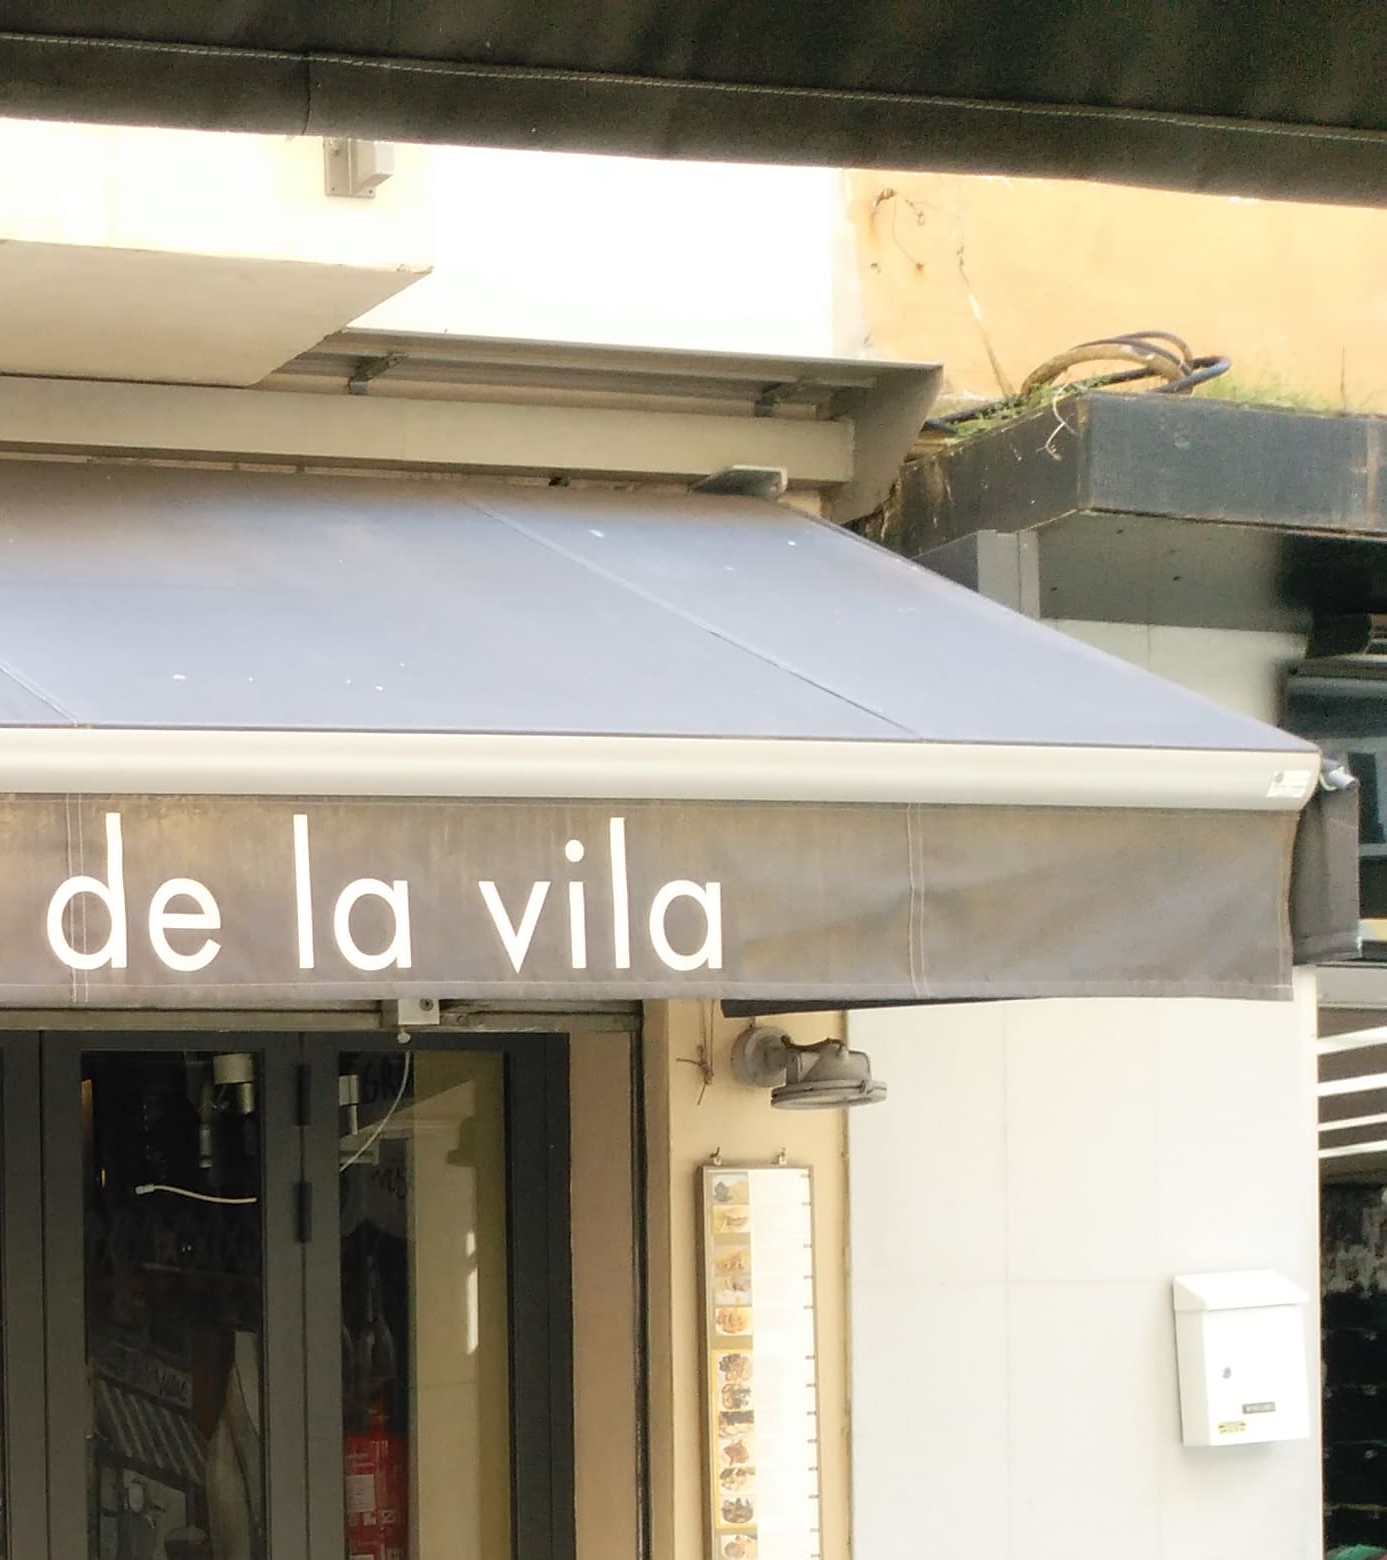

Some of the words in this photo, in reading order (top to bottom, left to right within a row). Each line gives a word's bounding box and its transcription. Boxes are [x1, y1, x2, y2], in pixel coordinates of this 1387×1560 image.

[46, 811, 222, 972] de
[293, 814, 413, 972] la
[478, 817, 723, 975] vila
